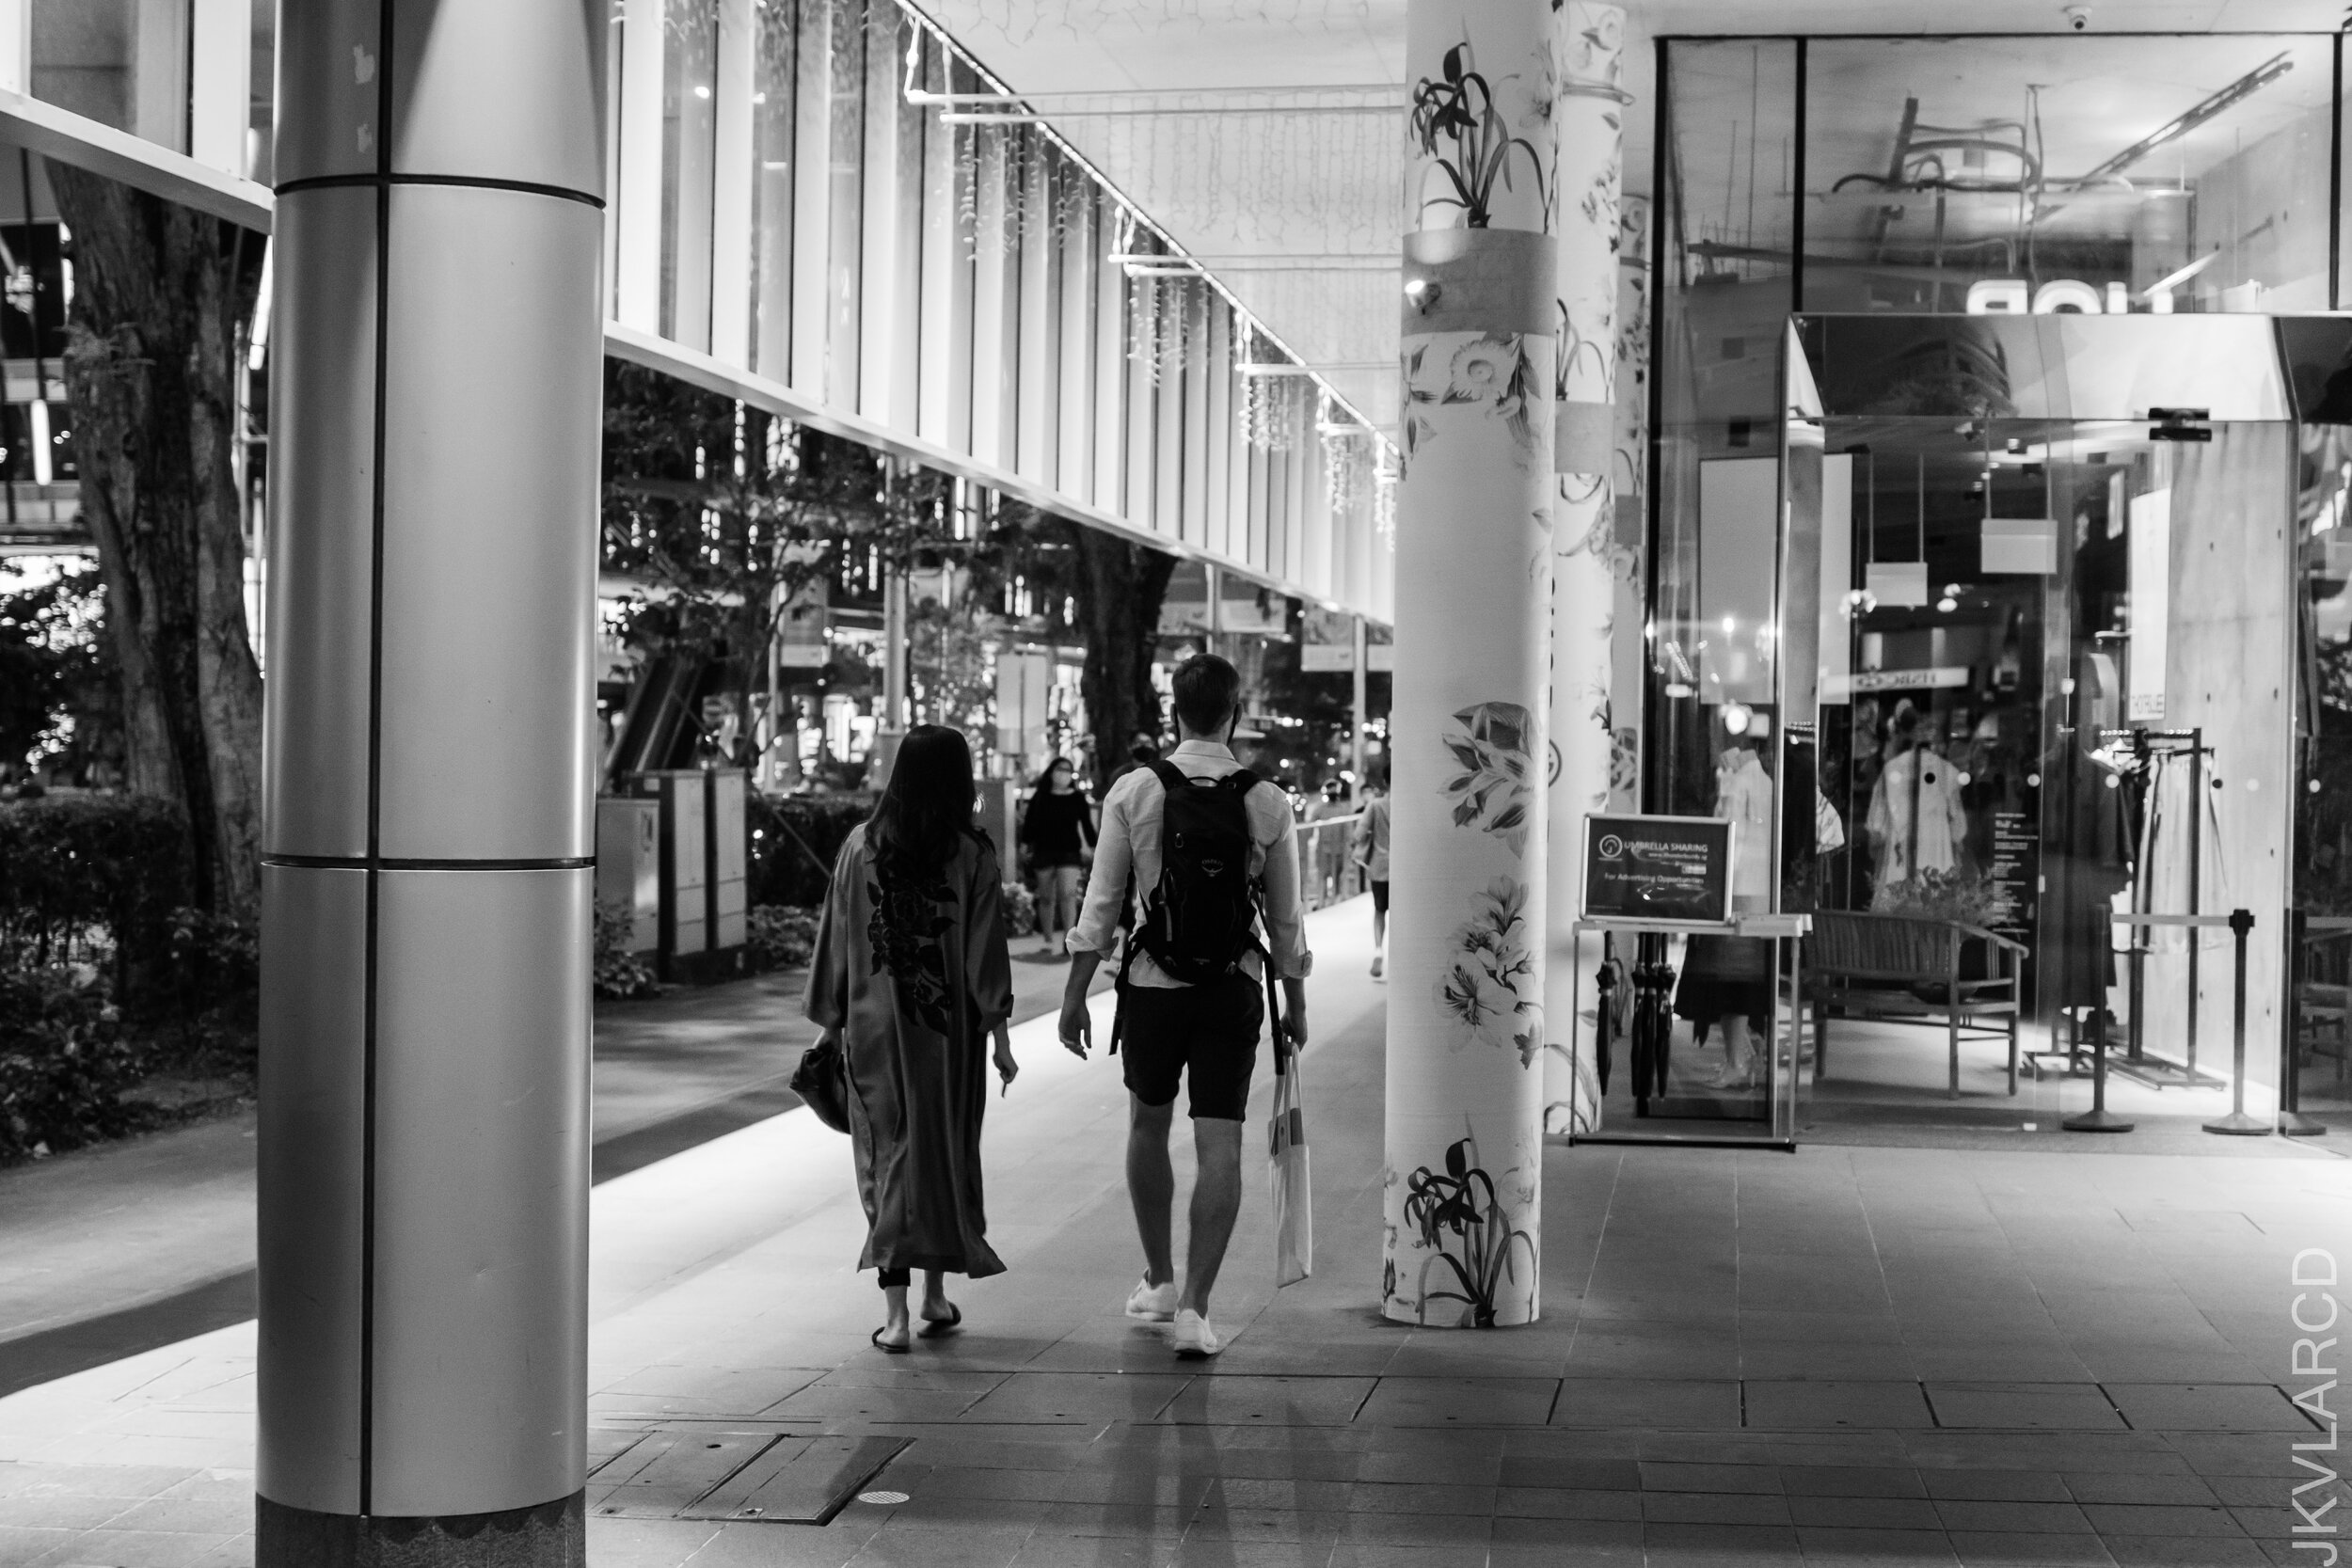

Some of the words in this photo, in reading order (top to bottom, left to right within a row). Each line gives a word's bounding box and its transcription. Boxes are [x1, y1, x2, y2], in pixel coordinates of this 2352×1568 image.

[1623, 841, 1669, 851] UMBRELLA
[1671, 842, 1708, 853] SHARING
[1604, 872, 1616, 880] For
[1617, 873, 1656, 883] Advertising
